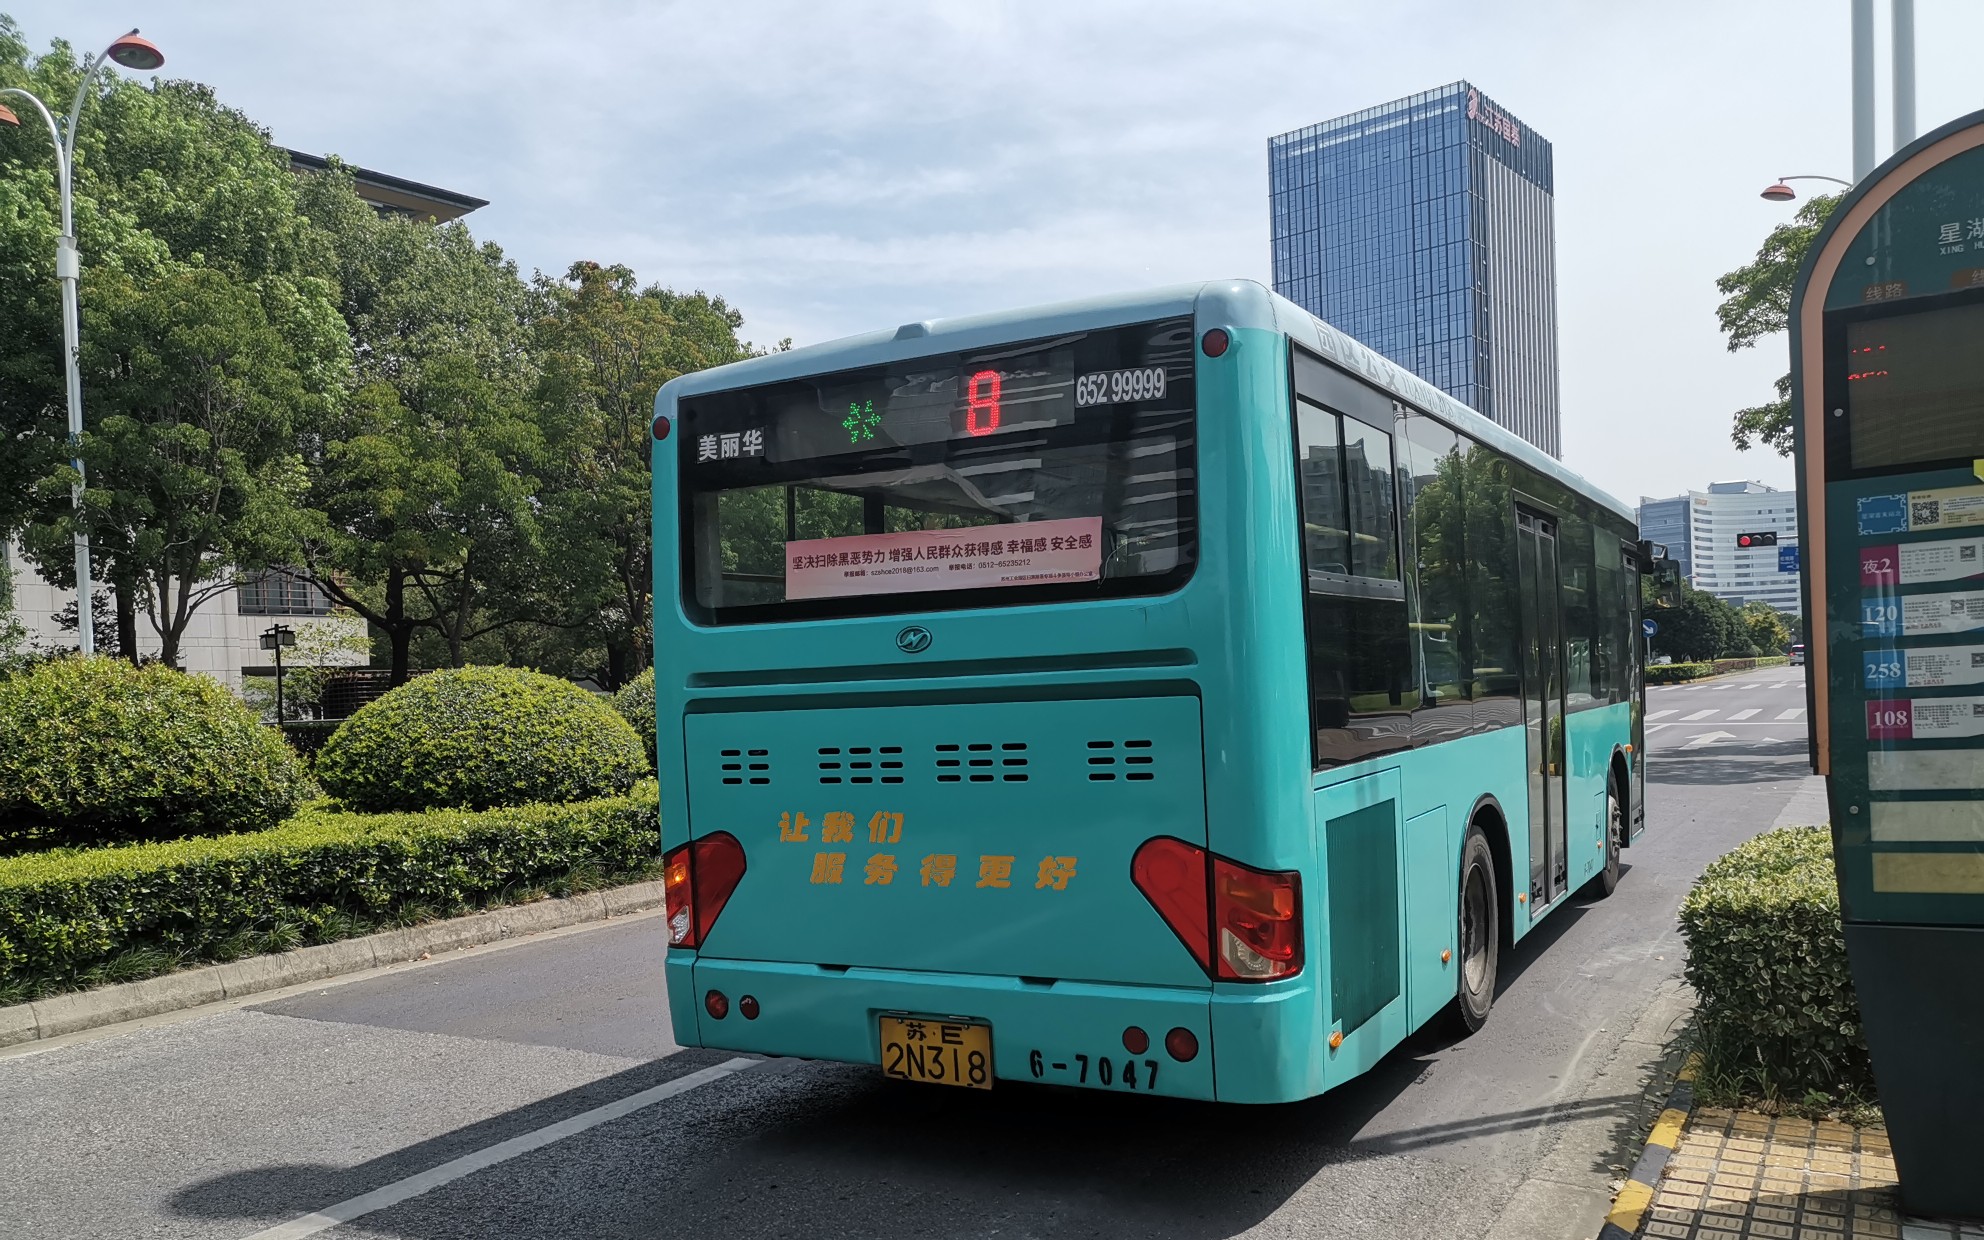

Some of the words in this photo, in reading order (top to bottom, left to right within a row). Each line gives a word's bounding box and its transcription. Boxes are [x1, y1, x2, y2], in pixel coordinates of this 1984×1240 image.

[1940, 244, 1964, 255] XING
[1865, 283, 1904, 301] 线路
[1076, 373, 1108, 406] 652
[1111, 367, 1165, 402] 99999
[966, 369, 1001, 437] 8
[698, 429, 763, 461] 美丽华
[792, 550, 886, 570] 坚决扫除黑恶势力
[888, 541, 1004, 563] 增强人民群众获得感
[1006, 537, 1048, 554] 幸福感
[1050, 534, 1093, 551] 安全感
[1863, 558, 1892, 575] 夜2
[1865, 606, 1899, 622] 120
[1867, 663, 1902, 679] 258
[1874, 711, 1908, 726] 108
[777, 811, 905, 843] 让我们
[809, 852, 1078, 891] 服务得更好
[886, 1042, 986, 1085] 2N318
[1029, 1049, 1159, 1090] 6-7047
